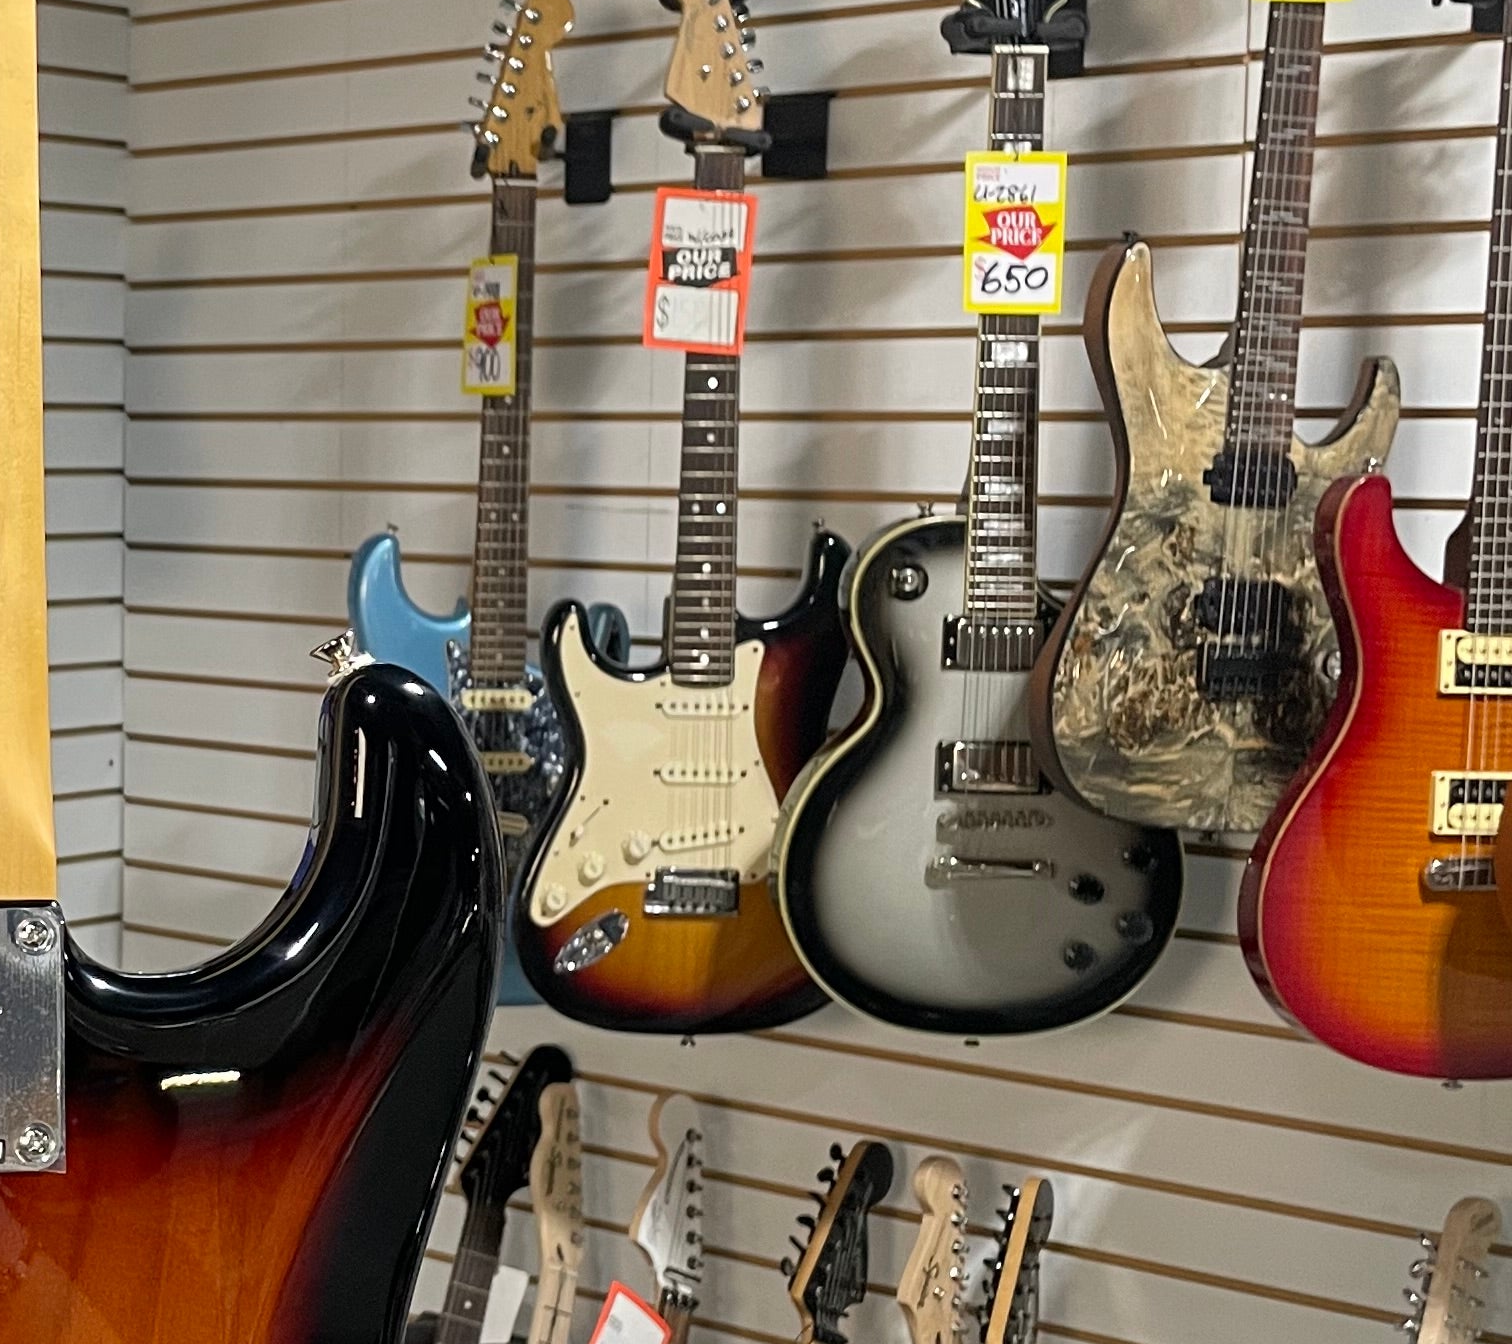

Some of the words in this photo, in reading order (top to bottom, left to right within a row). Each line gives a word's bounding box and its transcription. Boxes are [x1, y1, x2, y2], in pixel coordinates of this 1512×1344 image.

[996, 210, 1036, 229] OUR
[990, 227, 1043, 247] PRICE
[676, 249, 723, 266] OUR
[668, 261, 732, 282] PRICE
